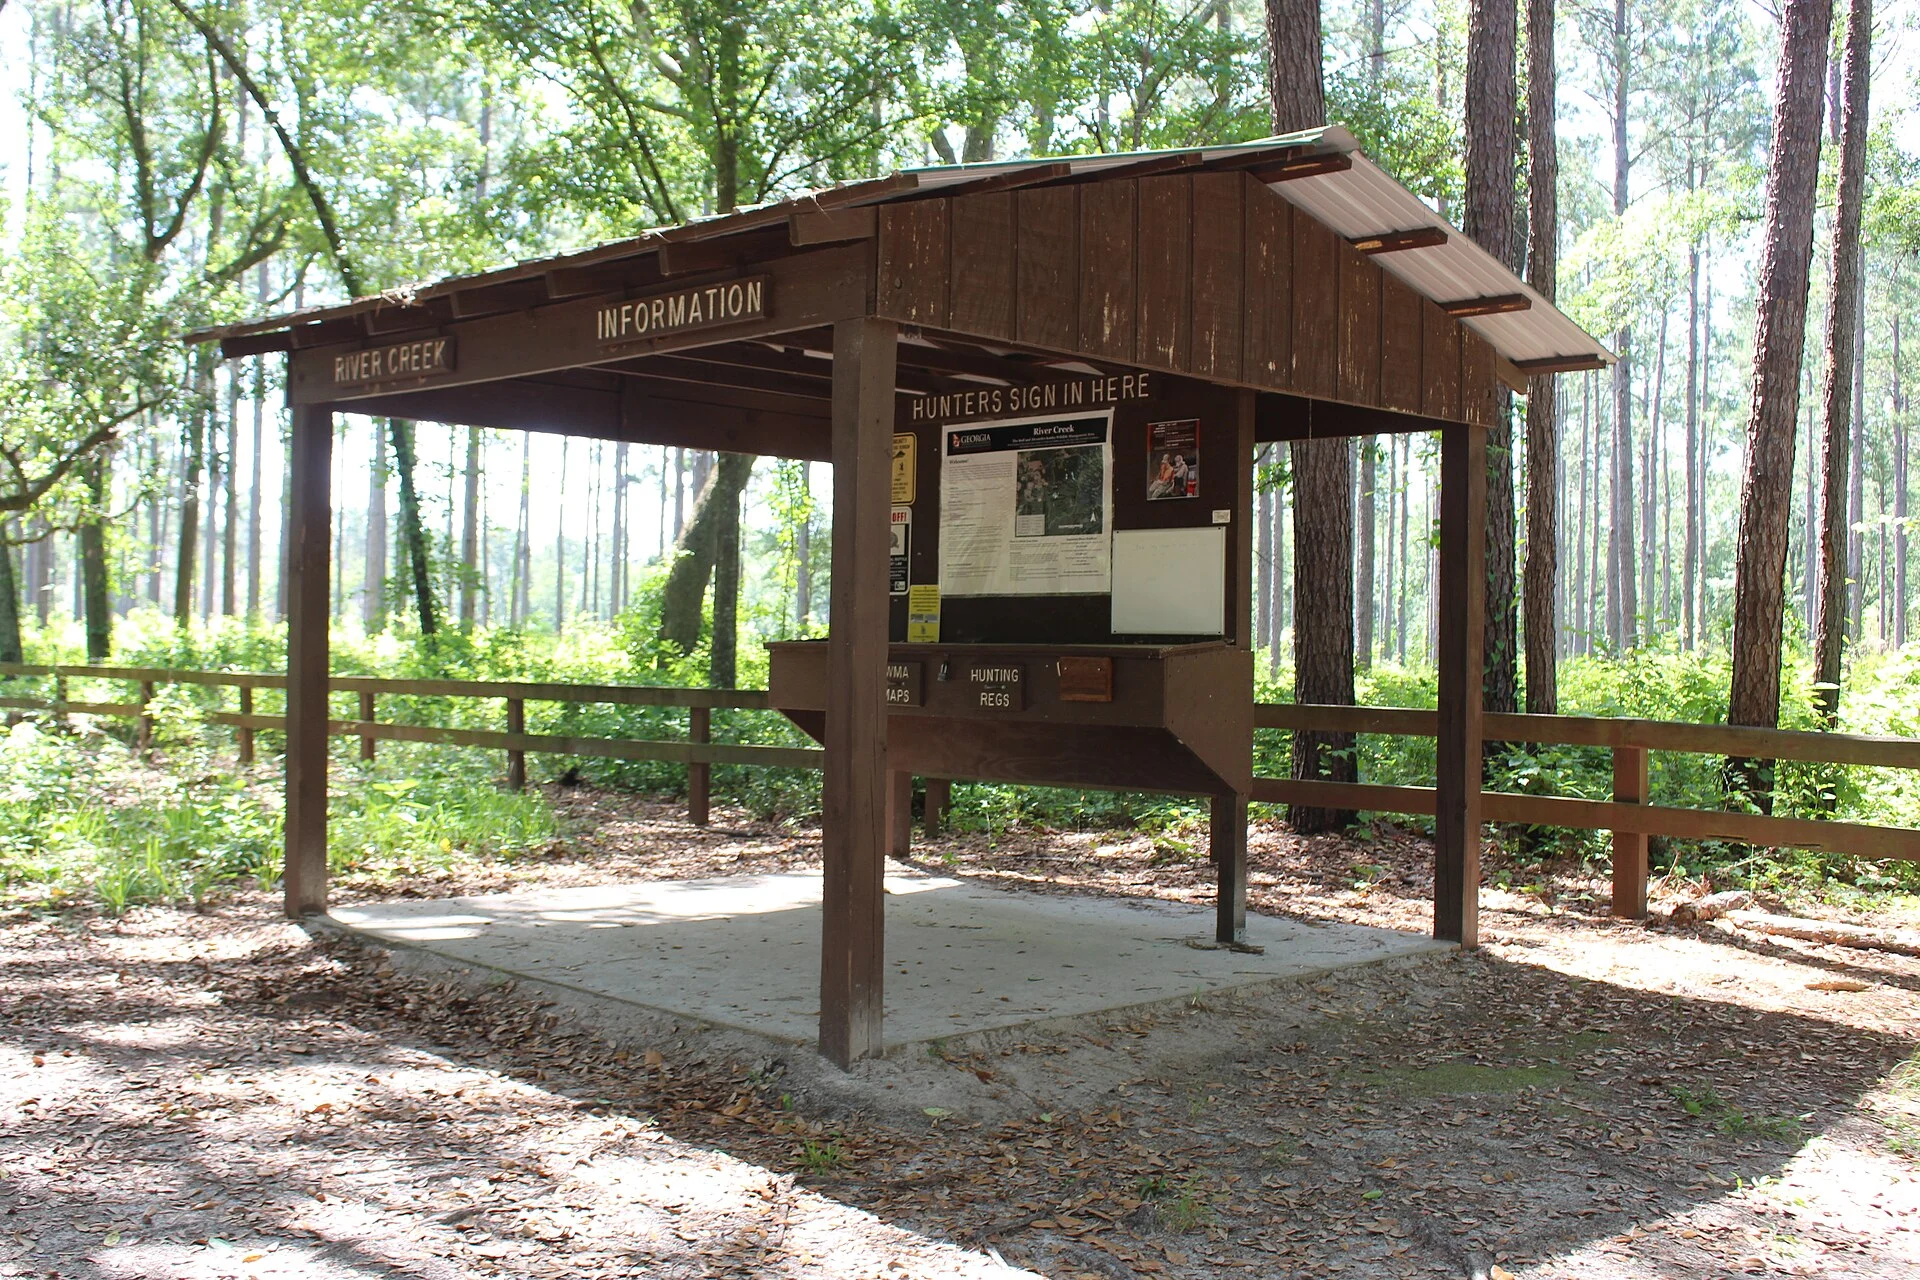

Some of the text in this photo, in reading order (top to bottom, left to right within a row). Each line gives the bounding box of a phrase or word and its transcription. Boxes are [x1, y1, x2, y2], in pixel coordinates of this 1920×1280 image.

[598, 281, 761, 340] INFORMATION
[335, 340, 446, 382] RIVER CREEK
[913, 373, 1149, 420] HUNTERS SIGN IN HERE
[1033, 424, 1075, 436] River Creek
[961, 433, 991, 443] GEORGIA
[892, 511, 907, 522] OFF!
[970, 669, 1019, 683] HUNTING
[979, 693, 1010, 708] REGS
